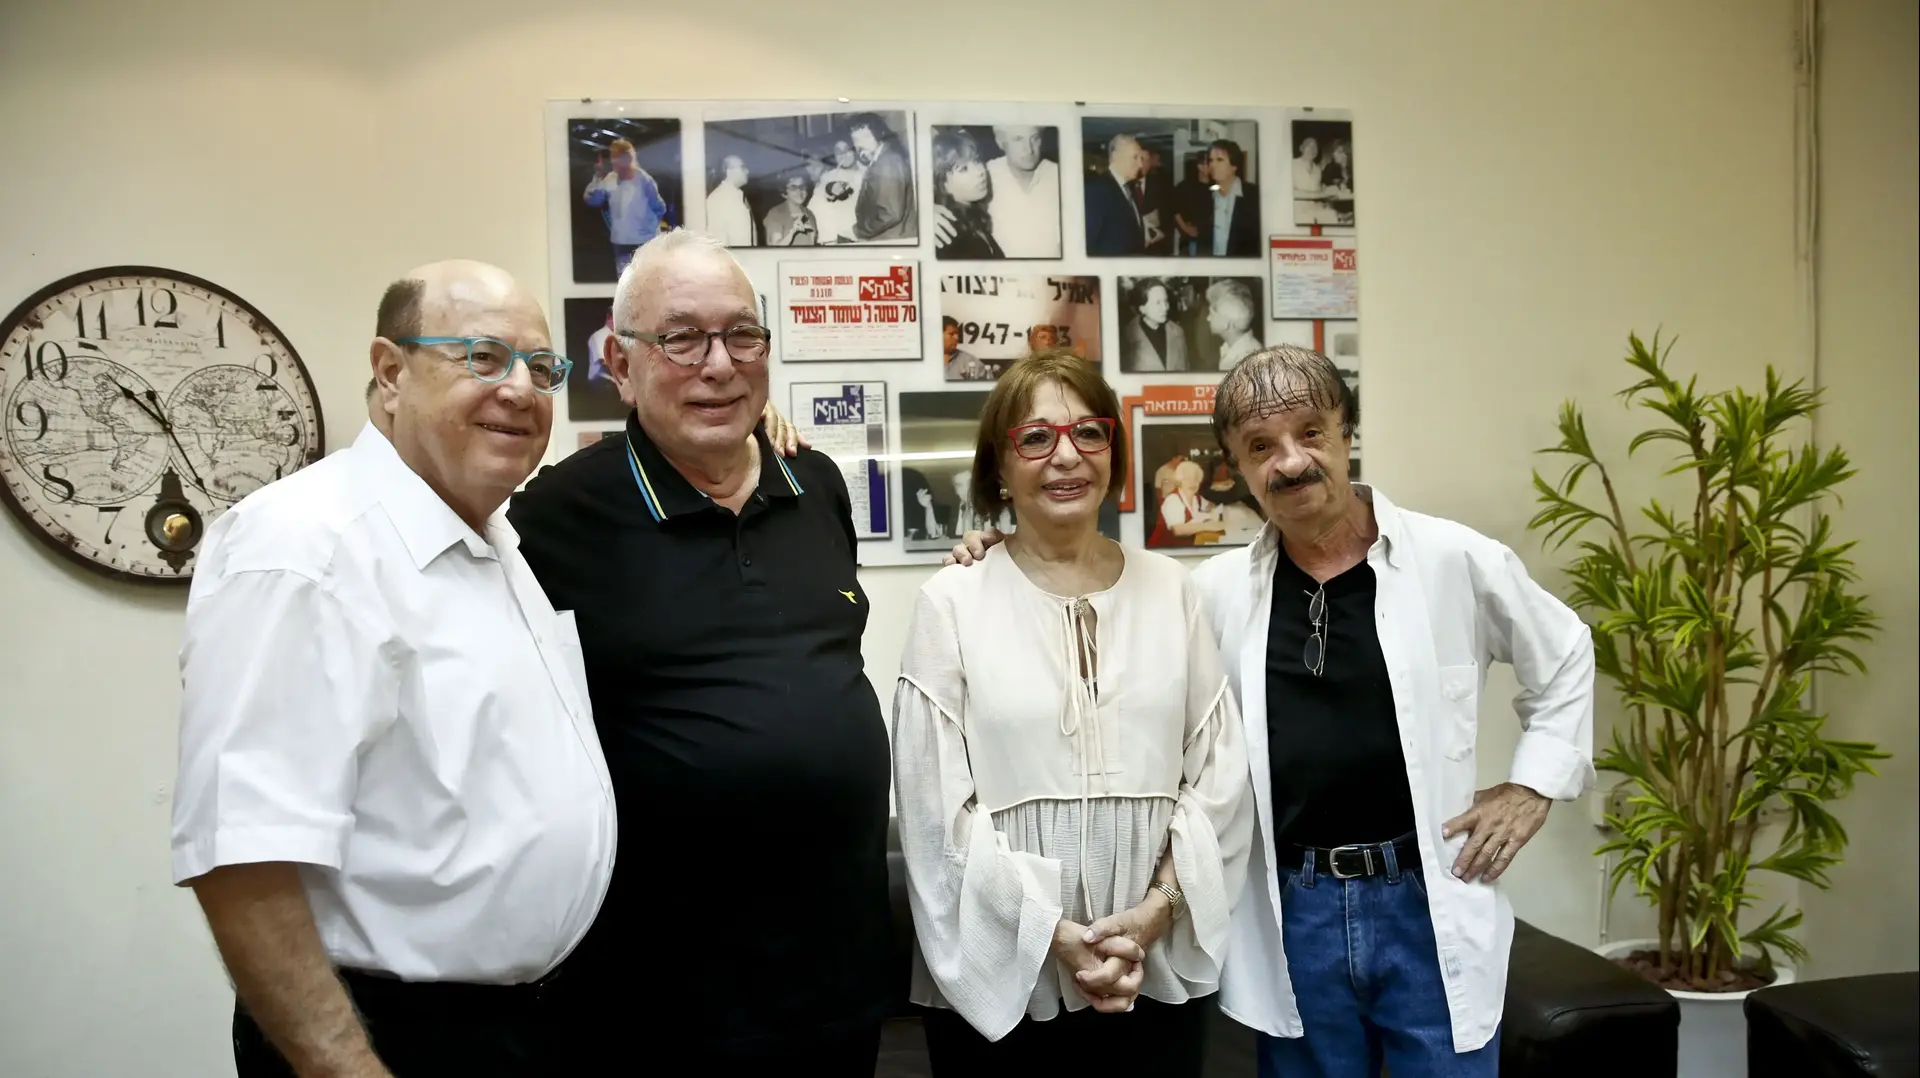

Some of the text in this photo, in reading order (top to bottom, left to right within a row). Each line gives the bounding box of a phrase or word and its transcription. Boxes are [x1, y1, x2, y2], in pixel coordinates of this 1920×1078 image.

[861, 279, 910, 299] צוותא
[1047, 277, 1094, 303] אמיל
[75, 299, 110, 340] 11
[137, 287, 179, 329] 12
[789, 305, 827, 323] הצעיר
[874, 304, 900, 323] שנה
[901, 304, 917, 323] 70
[217, 311, 228, 348] 1
[24, 338, 68, 382] 10
[254, 354, 279, 391] 2
[16, 402, 48, 441] 9
[276, 410, 299, 447] 3
[815, 400, 862, 423] צוותא
[42, 463, 75, 504] 8
[97, 506, 127, 545] 7
